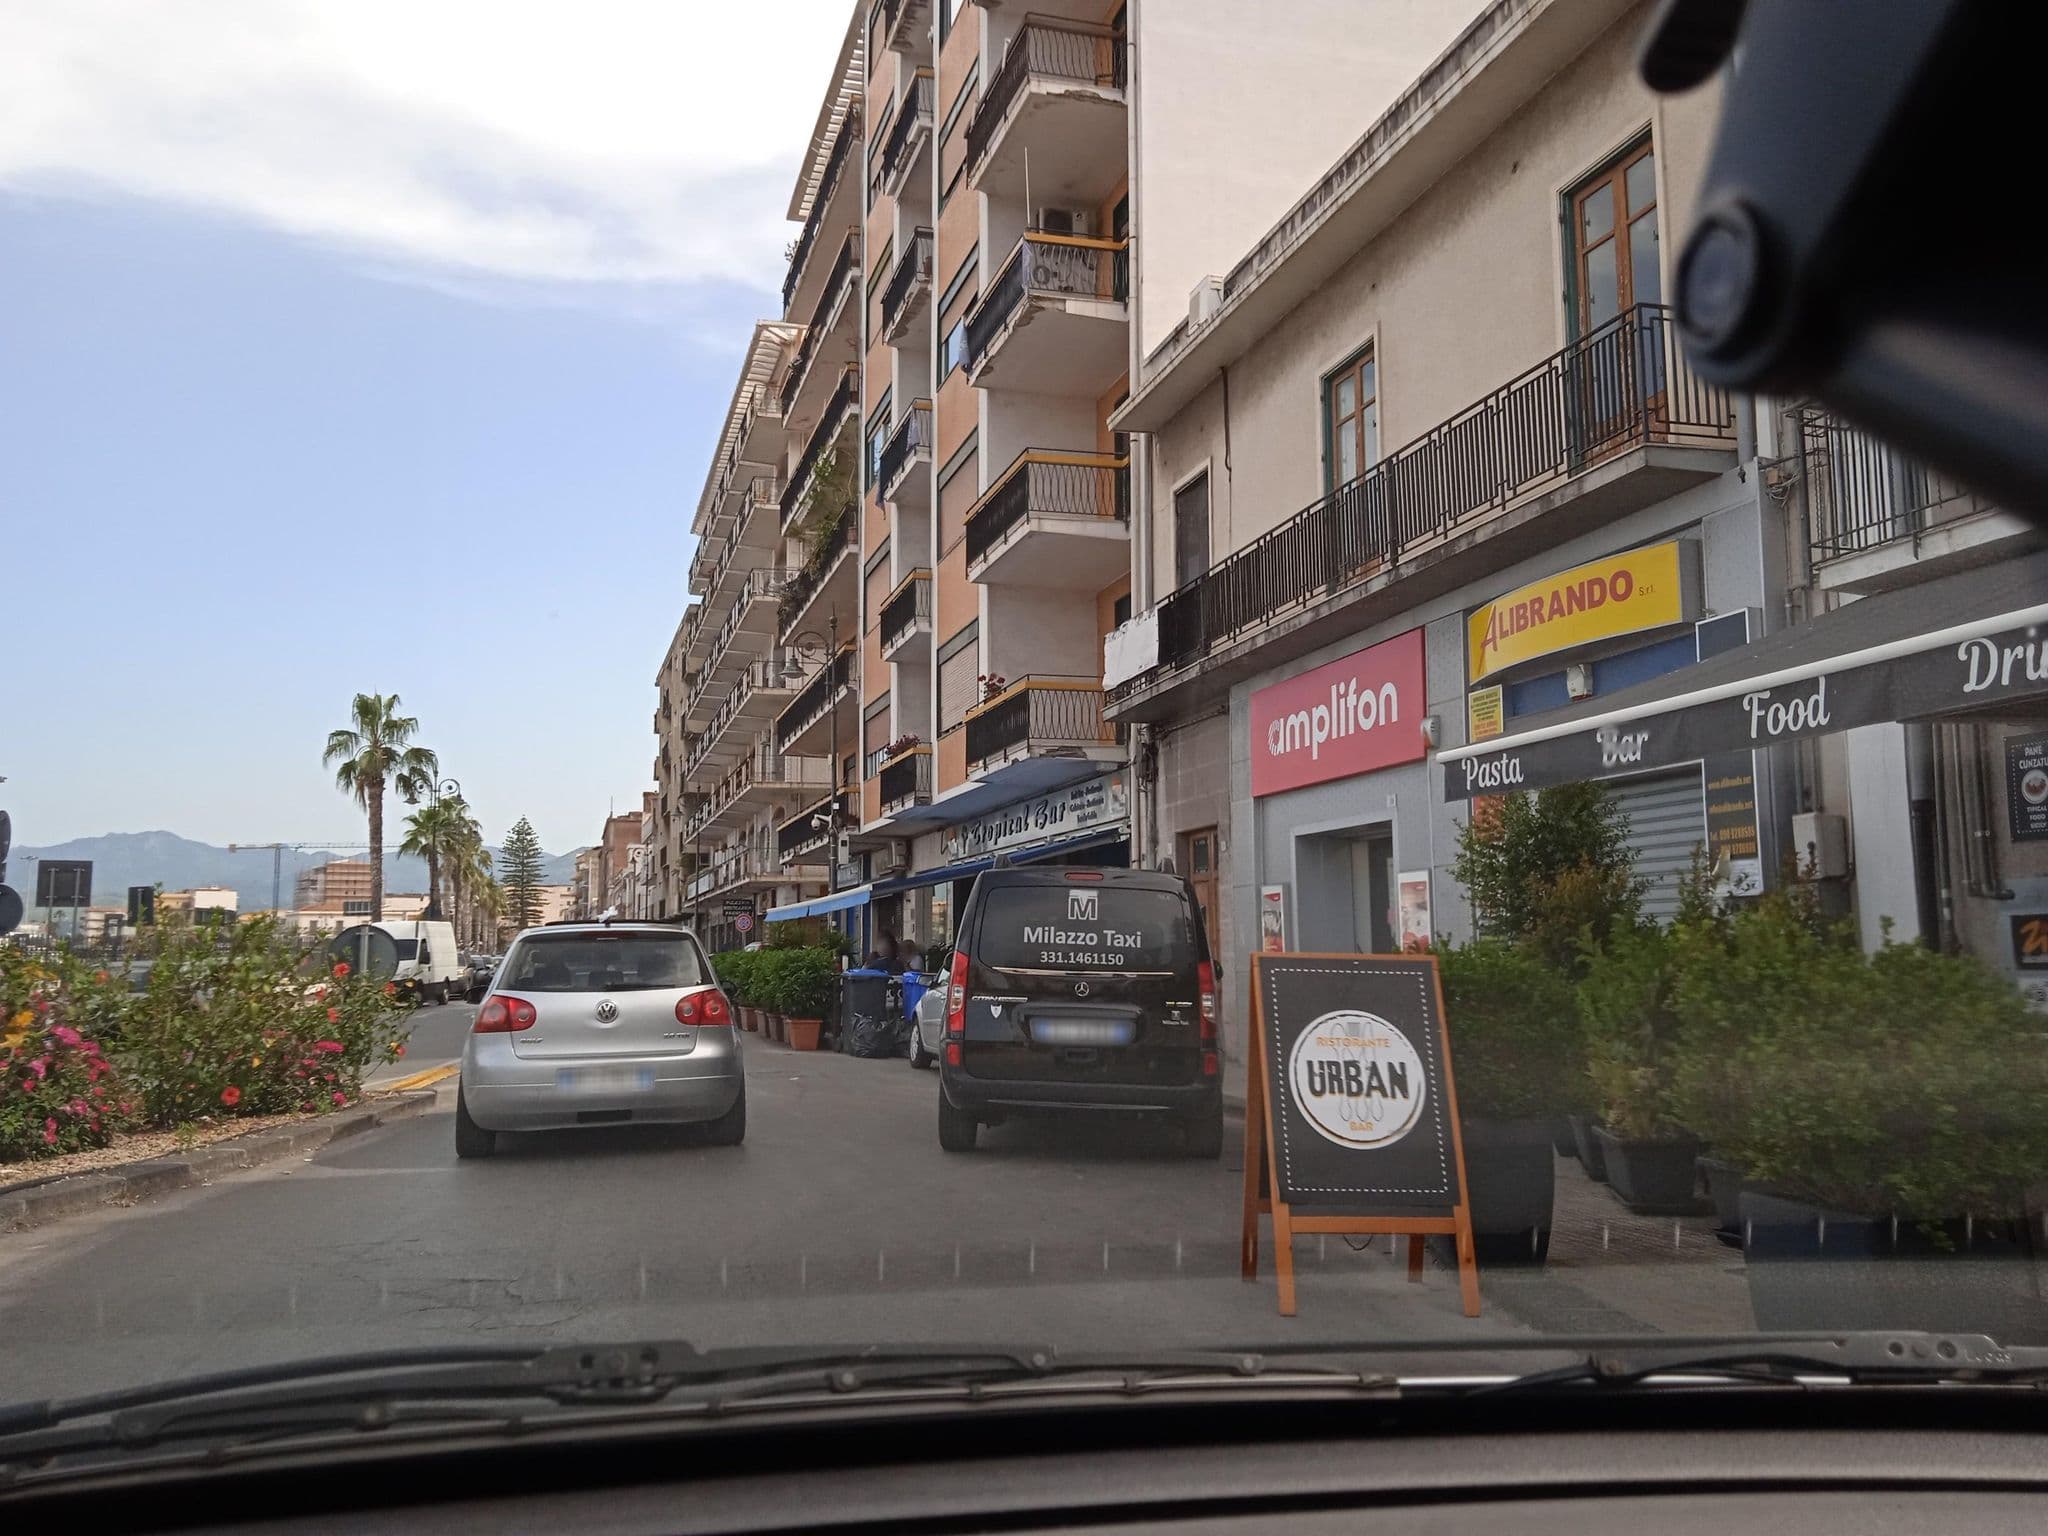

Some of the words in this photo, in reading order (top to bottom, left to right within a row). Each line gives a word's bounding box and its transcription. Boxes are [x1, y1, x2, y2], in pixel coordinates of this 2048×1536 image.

[1479, 569, 1633, 658] ALIBRANDO
[1267, 676, 1398, 760] amplifon
[1742, 674, 1830, 739] Food
[1596, 727, 1649, 769] Bar
[2024, 745, 2043, 757] PANE
[1461, 752, 1524, 791] Pasta
[1023, 926, 1098, 946] Milazzo
[1103, 929, 1142, 949] Taxi
[1040, 951, 1124, 966] 331.1461150
[1316, 1036, 1391, 1048] RISTORANTE
[1306, 1060, 1410, 1099] URBAN
[1349, 1121, 1374, 1131] BAR
